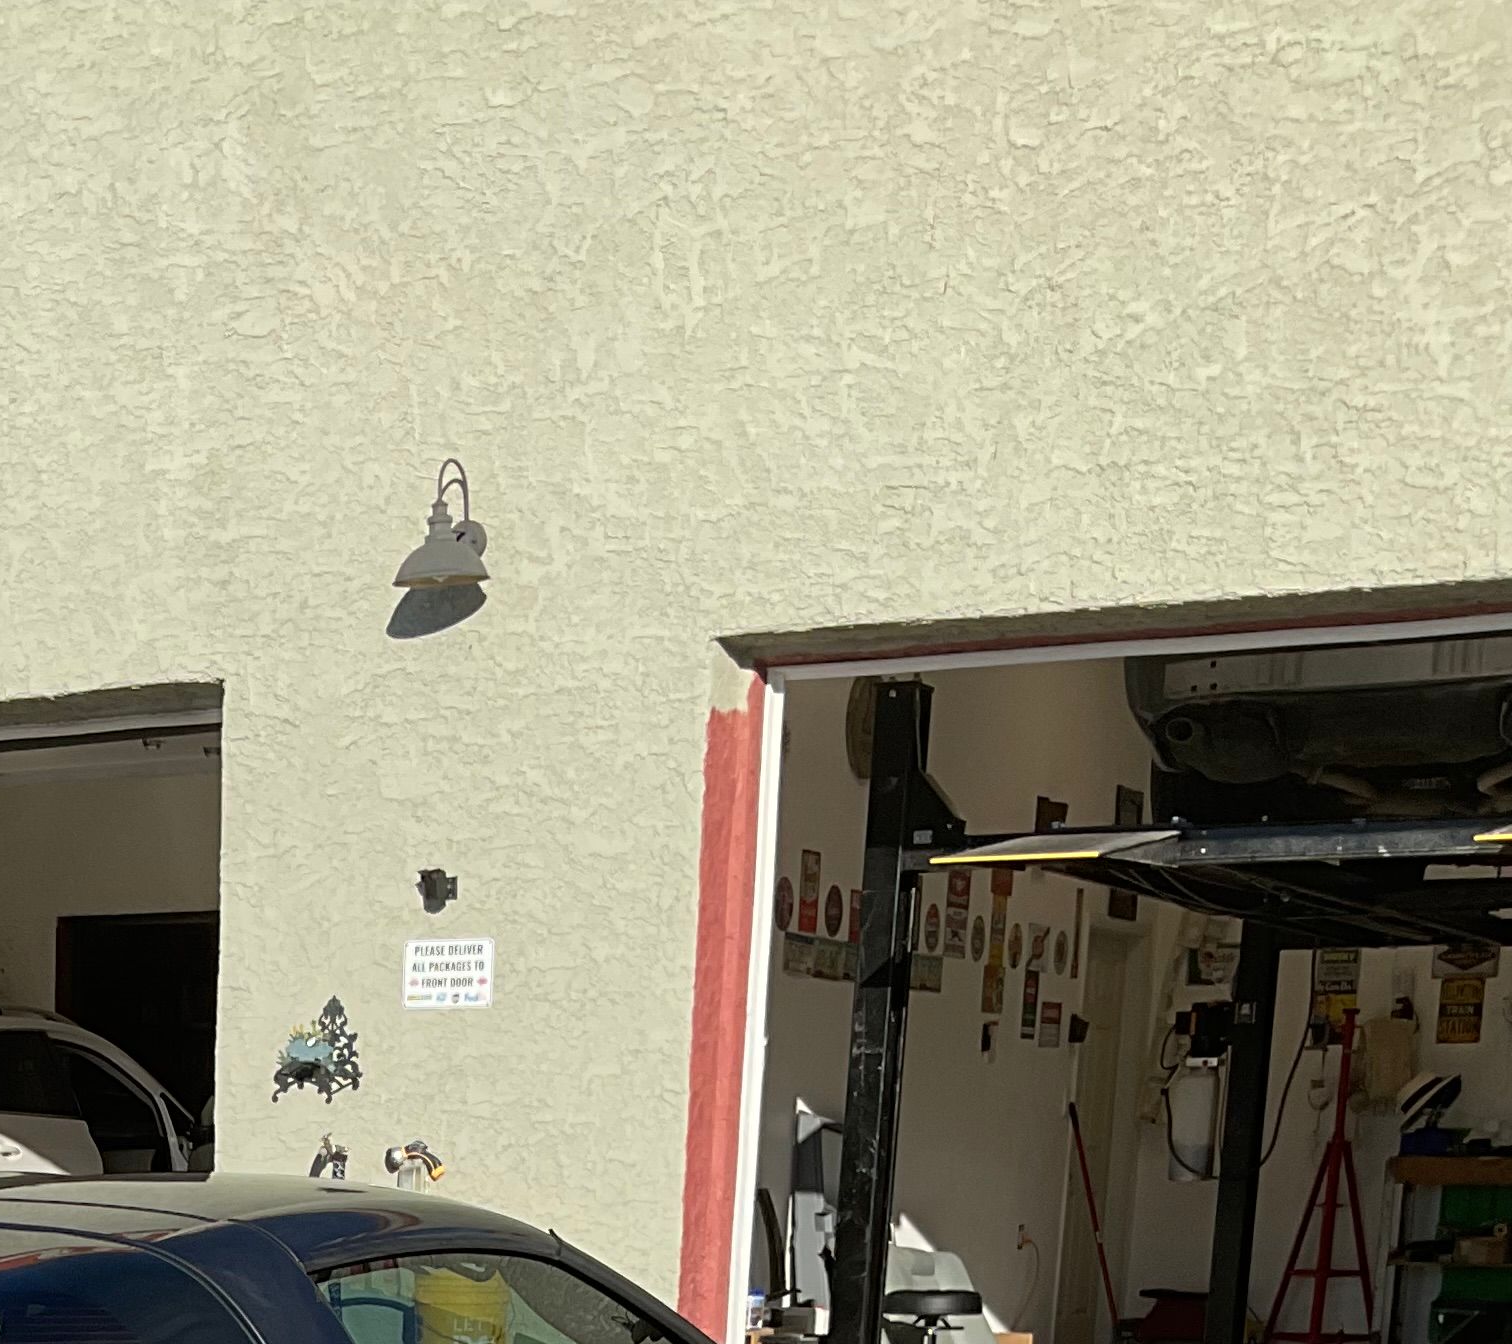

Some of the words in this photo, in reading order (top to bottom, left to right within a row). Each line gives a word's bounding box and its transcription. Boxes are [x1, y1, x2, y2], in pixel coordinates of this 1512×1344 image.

[414, 945, 445, 956] PLEASE
[448, 944, 483, 955] DELIVER
[412, 962, 426, 972] ALL
[429, 961, 471, 972] PACKAGES
[474, 960, 485, 971] TO
[421, 977, 447, 988] FRONT
[450, 977, 474, 987] DOOR
